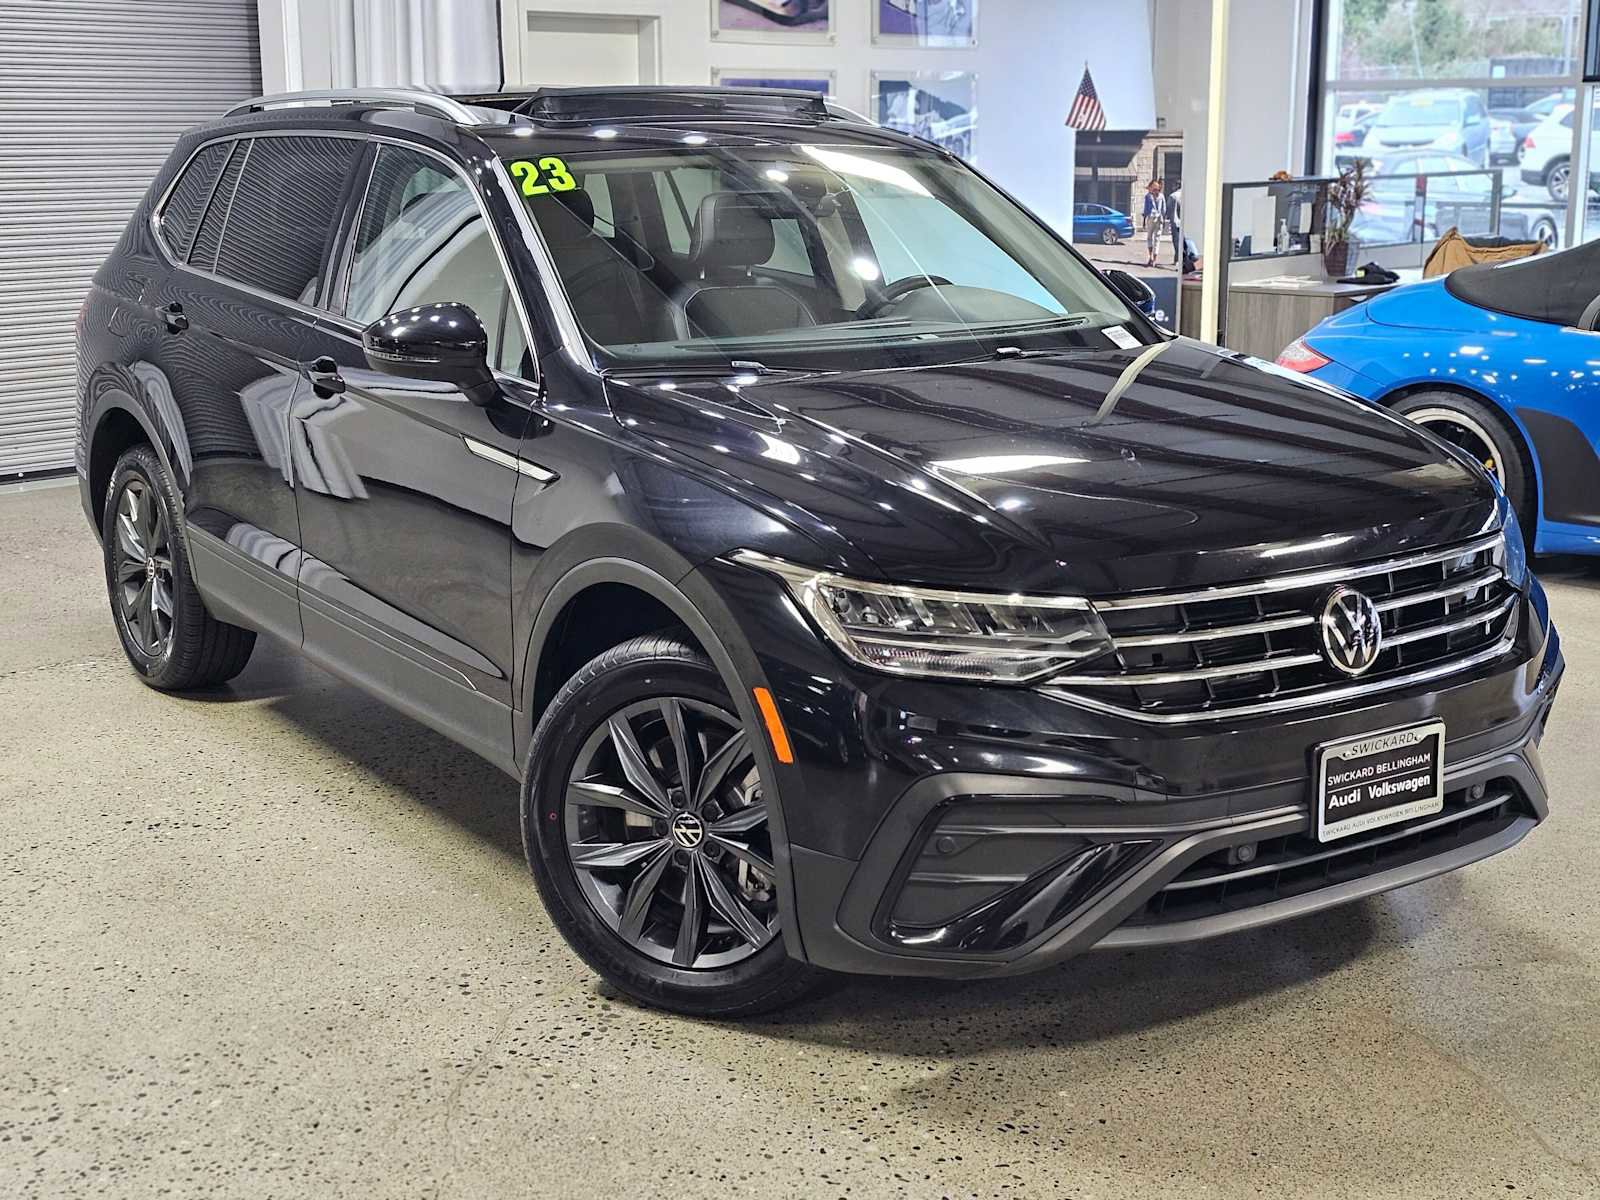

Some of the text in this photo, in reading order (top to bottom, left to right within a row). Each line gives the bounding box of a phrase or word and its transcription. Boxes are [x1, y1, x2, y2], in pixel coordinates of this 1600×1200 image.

[510, 157, 577, 196] 23
[1351, 732, 1414, 756] SWICKARD
[1327, 753, 1431, 786] SWICKARD BELLINGHAM
[1328, 774, 1431, 809] Audi Volkswagen
